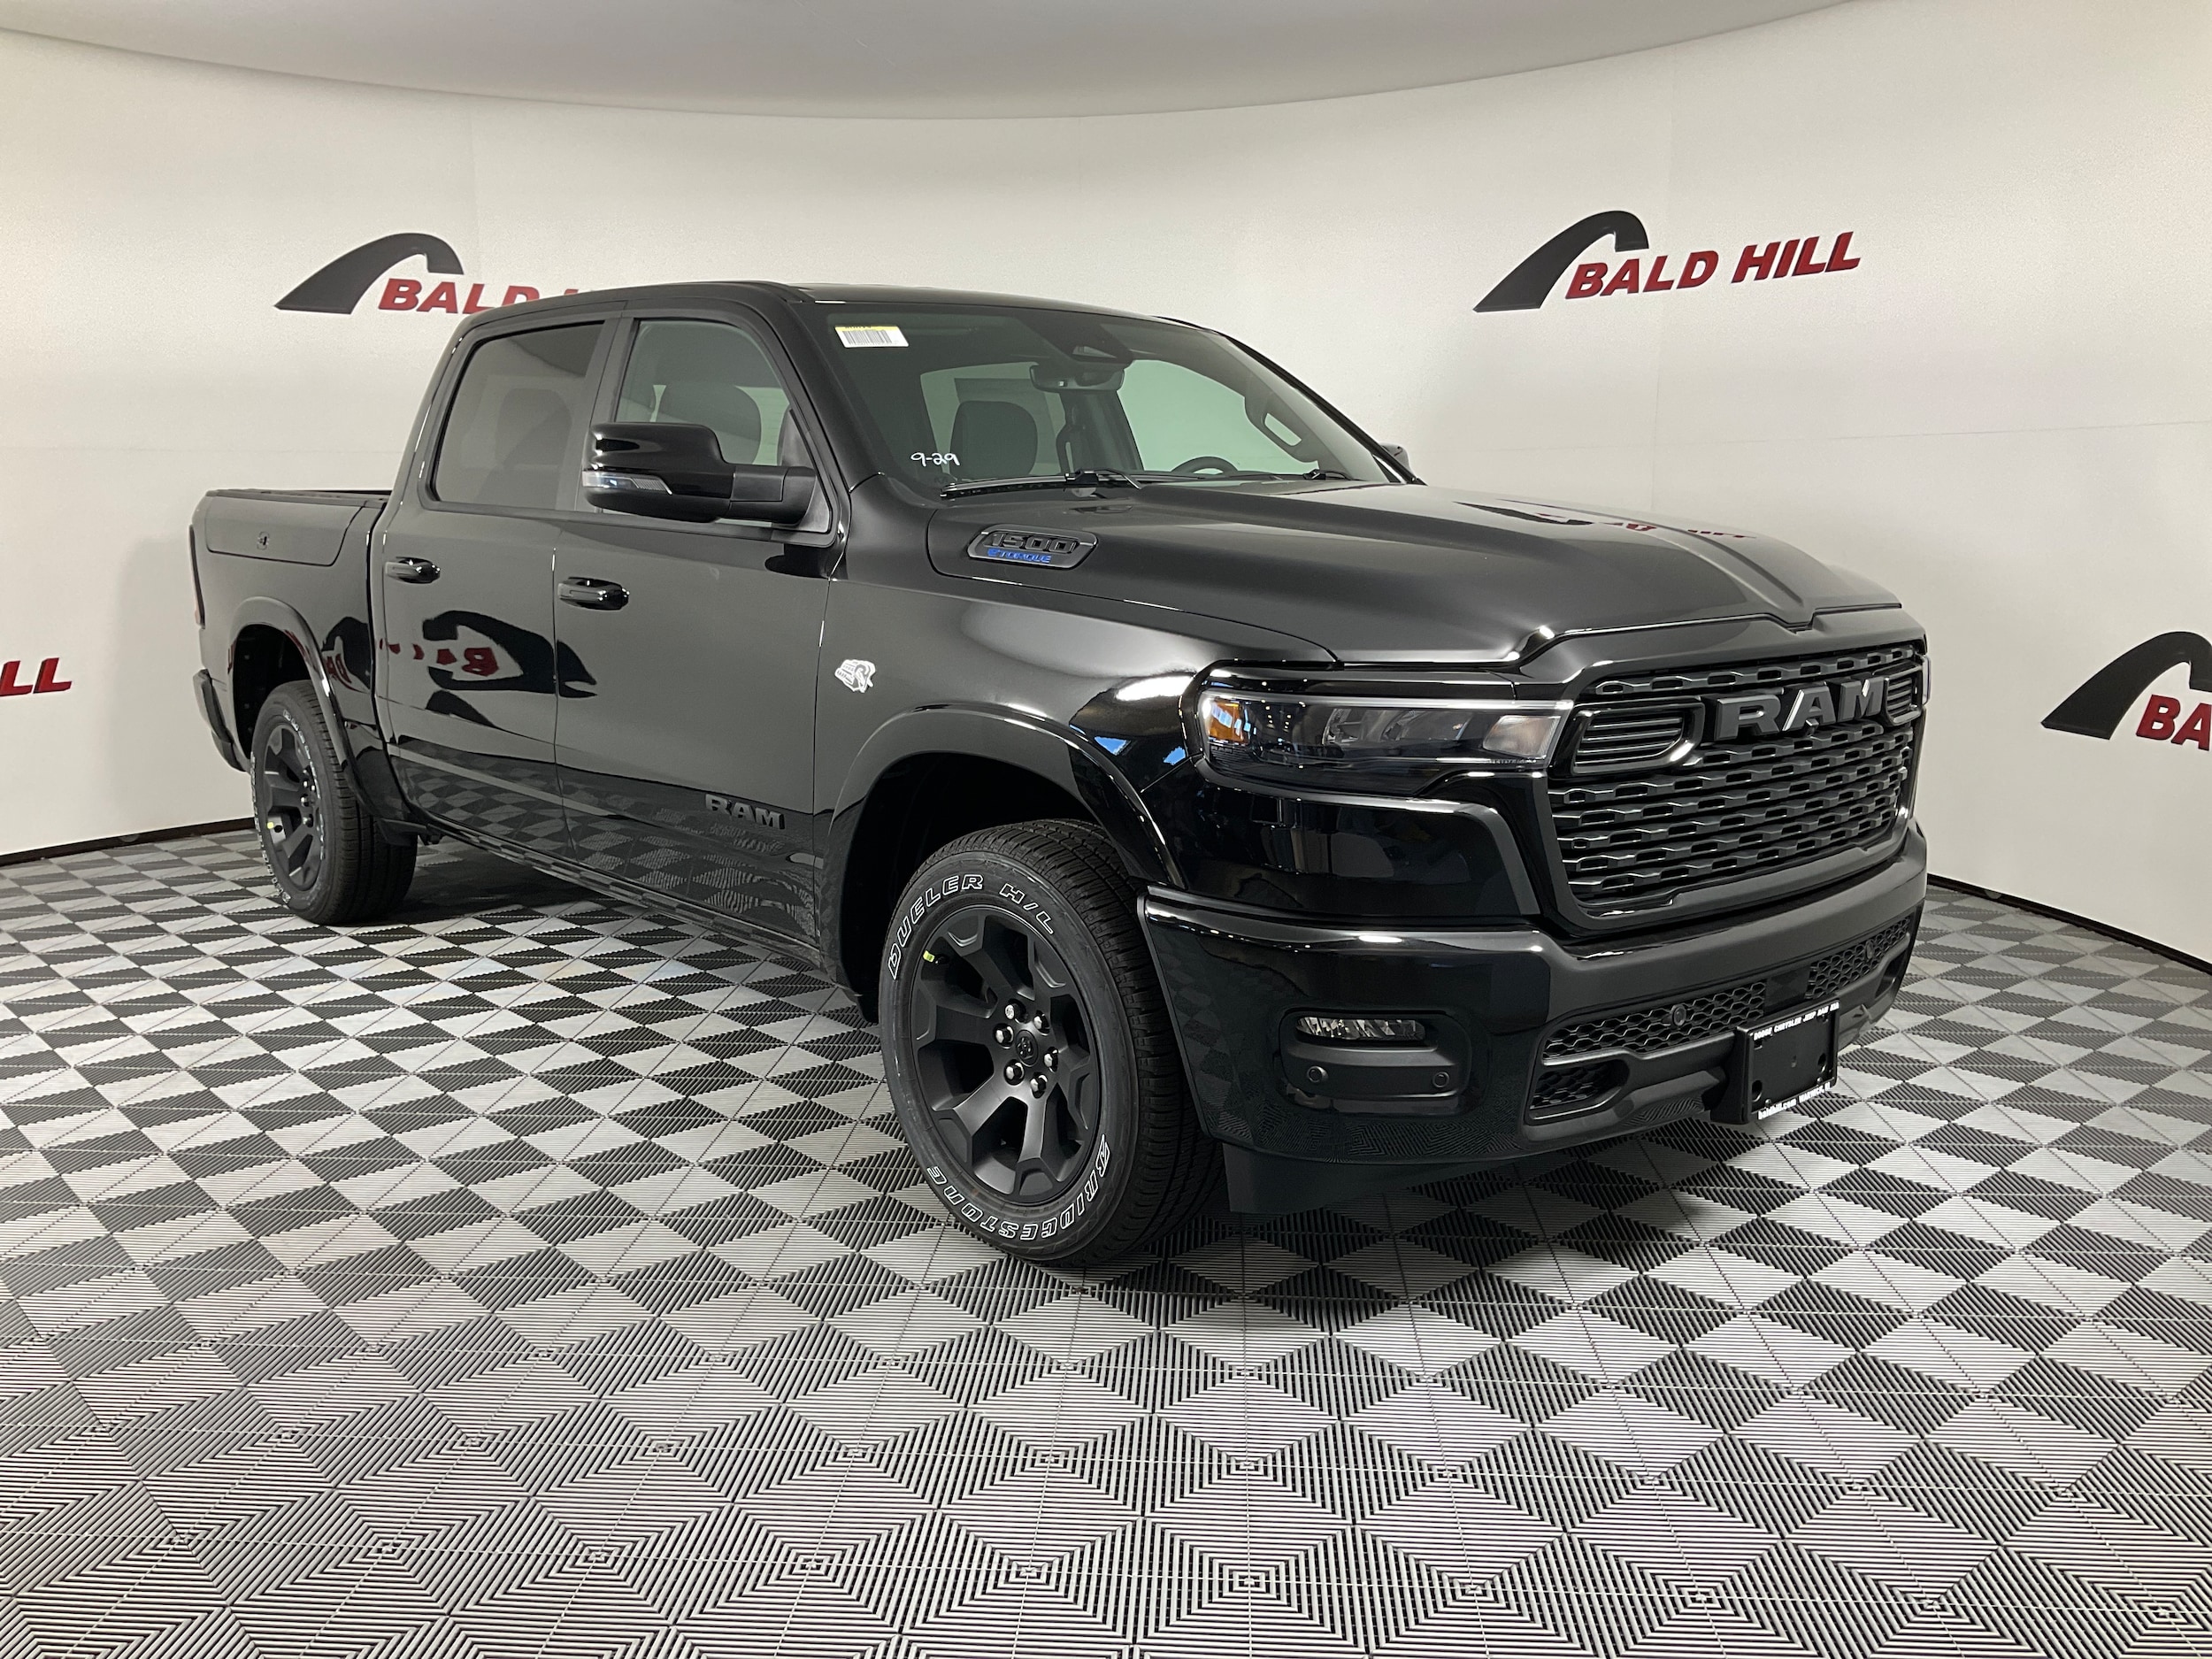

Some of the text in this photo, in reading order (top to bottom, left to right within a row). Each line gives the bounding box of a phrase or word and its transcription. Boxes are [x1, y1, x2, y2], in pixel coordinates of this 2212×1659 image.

[1564, 231, 1861, 300] BALD HILL
[910, 452, 961, 467] 9-29
[989, 532, 1077, 555] 1500
[1714, 675, 1885, 741] RAM
[705, 794, 786, 830] RAM
[887, 874, 1054, 980] DUELER H/L
[1753, 1026, 1773, 1041] DODGE
[1773, 1017, 1802, 1033] CHRYSLER
[1802, 1010, 1817, 1022] JEEP
[1816, 1005, 1830, 1017] RAM
[1757, 1098, 1797, 1120] baldhill.com
[926, 1133, 1110, 1240] BRIDGESTONE
